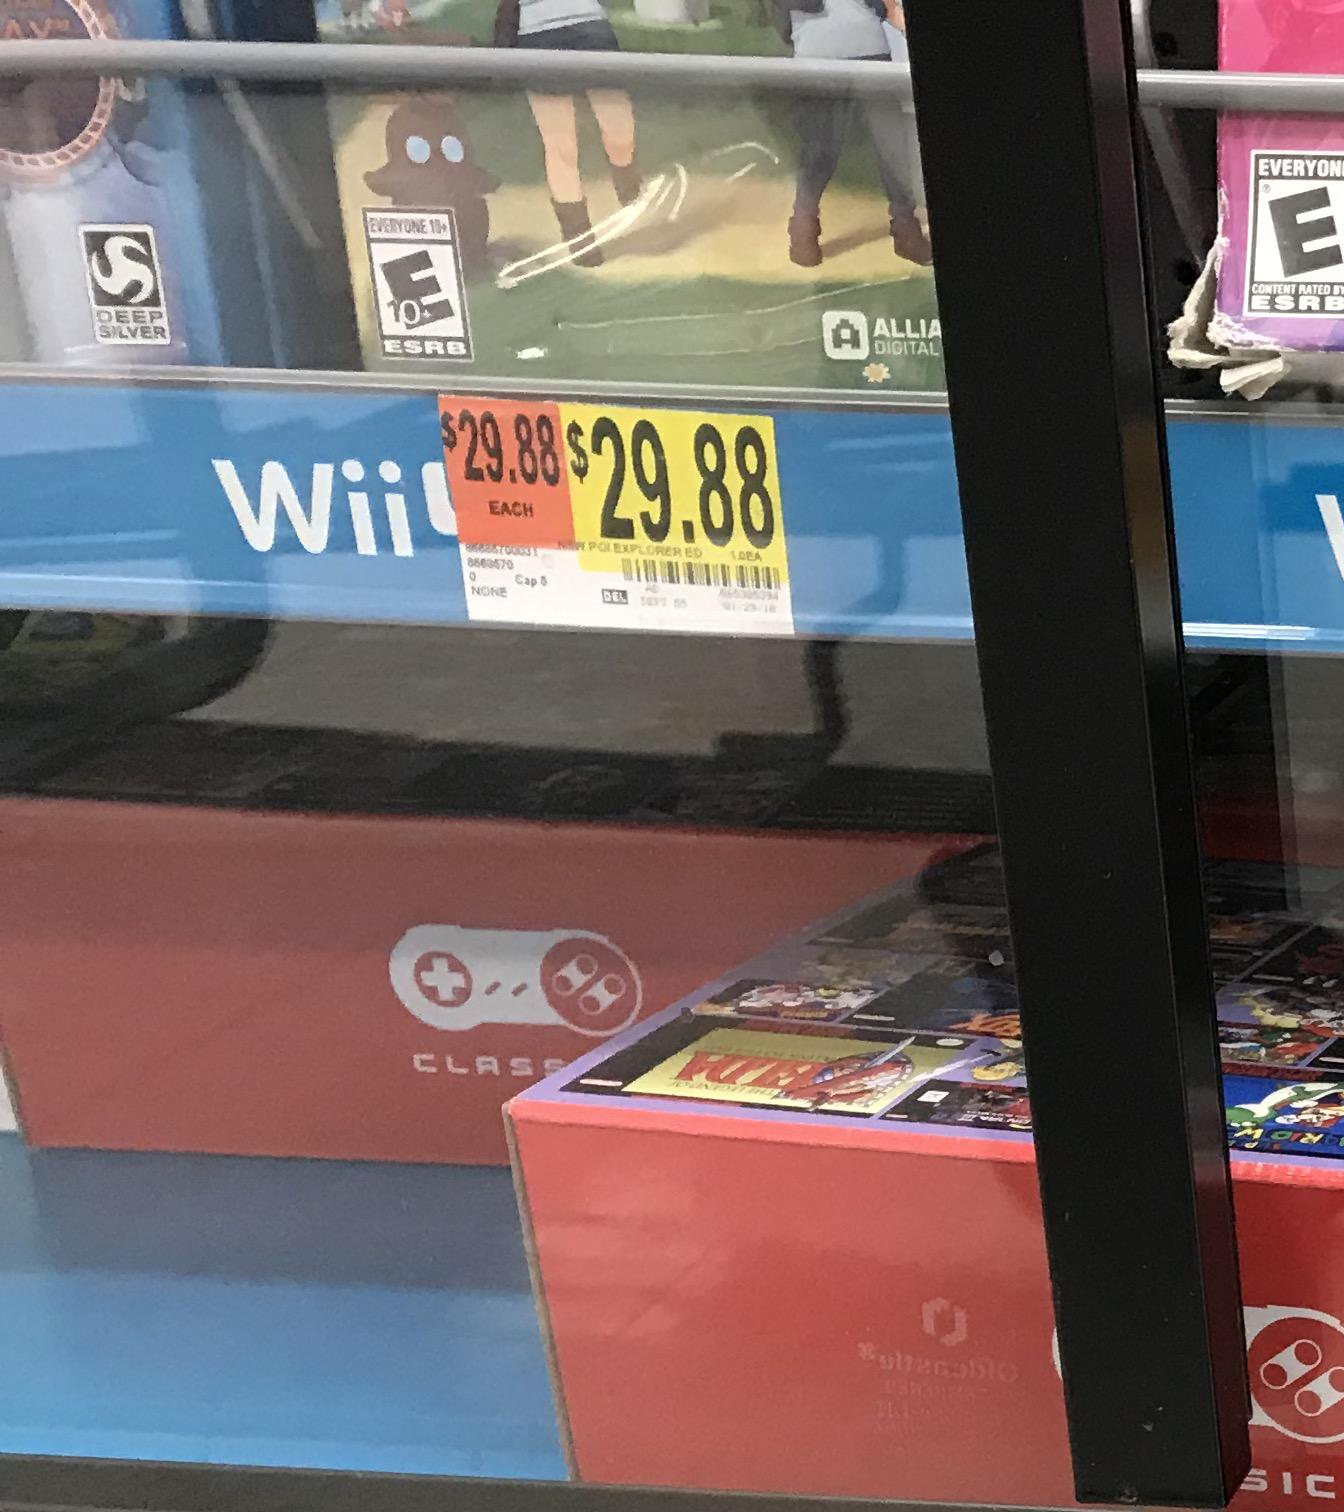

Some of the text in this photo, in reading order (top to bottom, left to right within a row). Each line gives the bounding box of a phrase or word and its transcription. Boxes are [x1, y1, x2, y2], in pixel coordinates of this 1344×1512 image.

[369, 217, 428, 234] EVERYONE
[1268, 186, 1344, 278] E
[1252, 284, 1296, 294] CONTENT
[1299, 285, 1331, 295] RATED
[96, 310, 163, 324] DEEP
[99, 325, 167, 339] SILVER
[874, 318, 942, 338] ALLIA
[383, 339, 466, 355] ESRB
[875, 341, 940, 356] DIGITAL
[441, 409, 560, 487] $29.88
[566, 416, 775, 549] $29.88
[213, 460, 412, 557] Wii
[489, 500, 534, 517] EACH
[515, 573, 537, 587] Cap
[471, 586, 507, 598] NONE
[413, 1053, 566, 1077] CLASS
